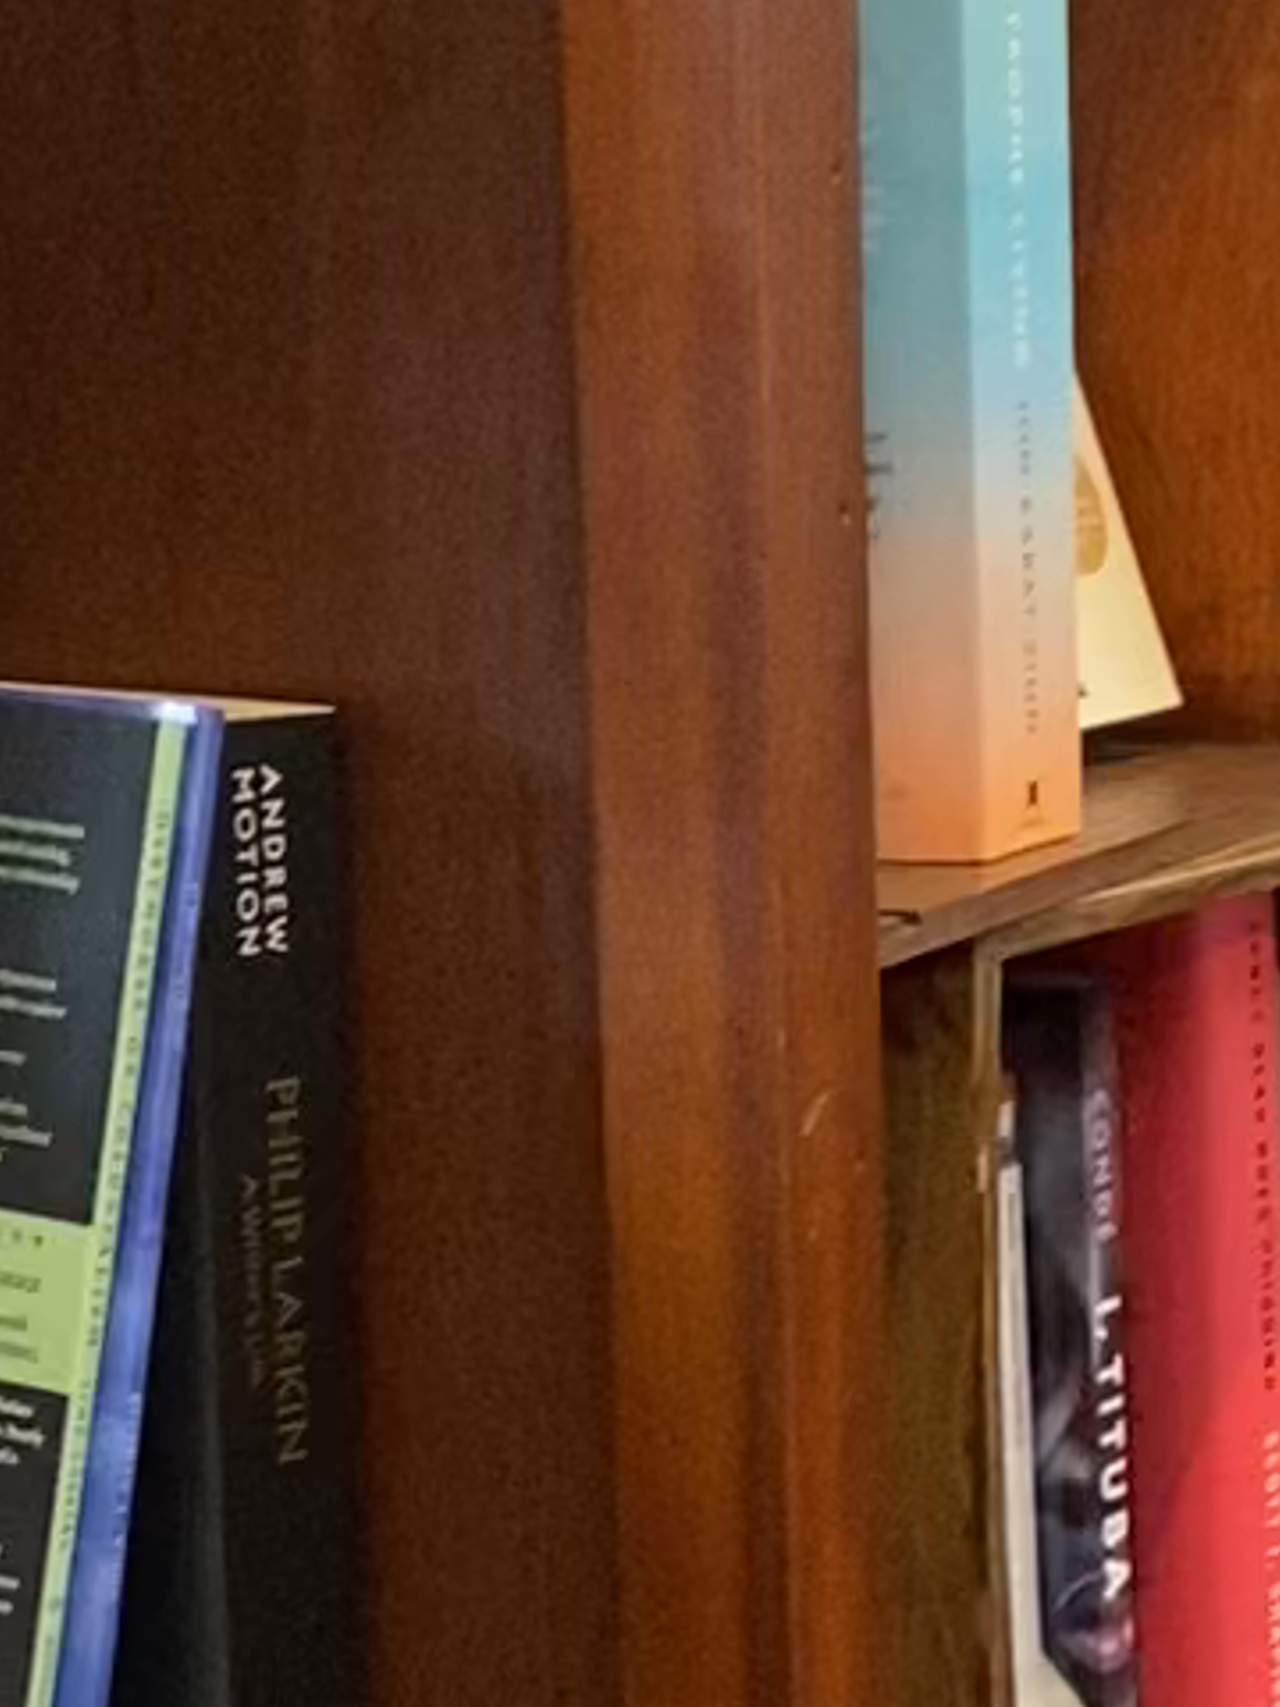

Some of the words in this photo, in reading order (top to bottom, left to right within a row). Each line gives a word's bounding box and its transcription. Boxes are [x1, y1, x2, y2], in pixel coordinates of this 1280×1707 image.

[229, 763, 262, 959] MOTION
[257, 762, 291, 956] ANDREW
[265, 1076, 308, 1246] PHILIP
[270, 1255, 312, 1466] LARKIN
[1094, 1351, 1135, 1600] TITUBA
